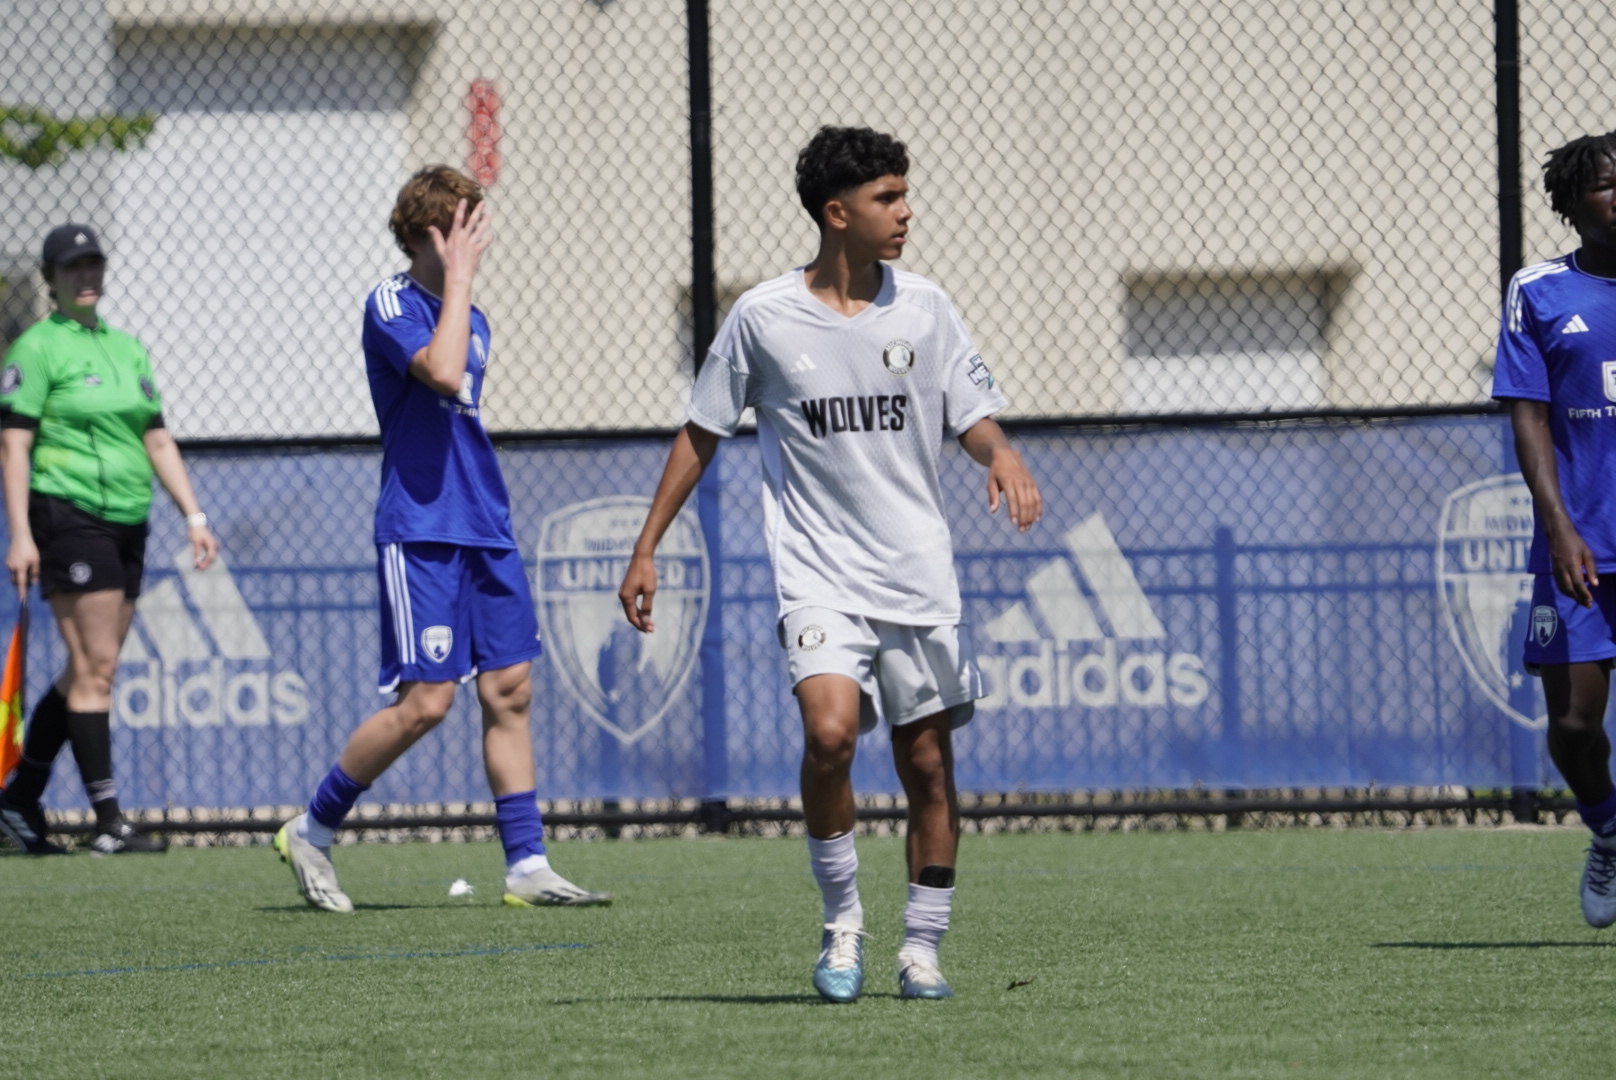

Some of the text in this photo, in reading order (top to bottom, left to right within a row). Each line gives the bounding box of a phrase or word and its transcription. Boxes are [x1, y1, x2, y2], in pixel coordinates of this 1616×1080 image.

[800, 394, 907, 439] WOLVES
[1568, 405, 1616, 419] FIFTH T
[1462, 539, 1532, 569] UNI
[561, 559, 686, 589] UNIED
[110, 659, 310, 728] didas
